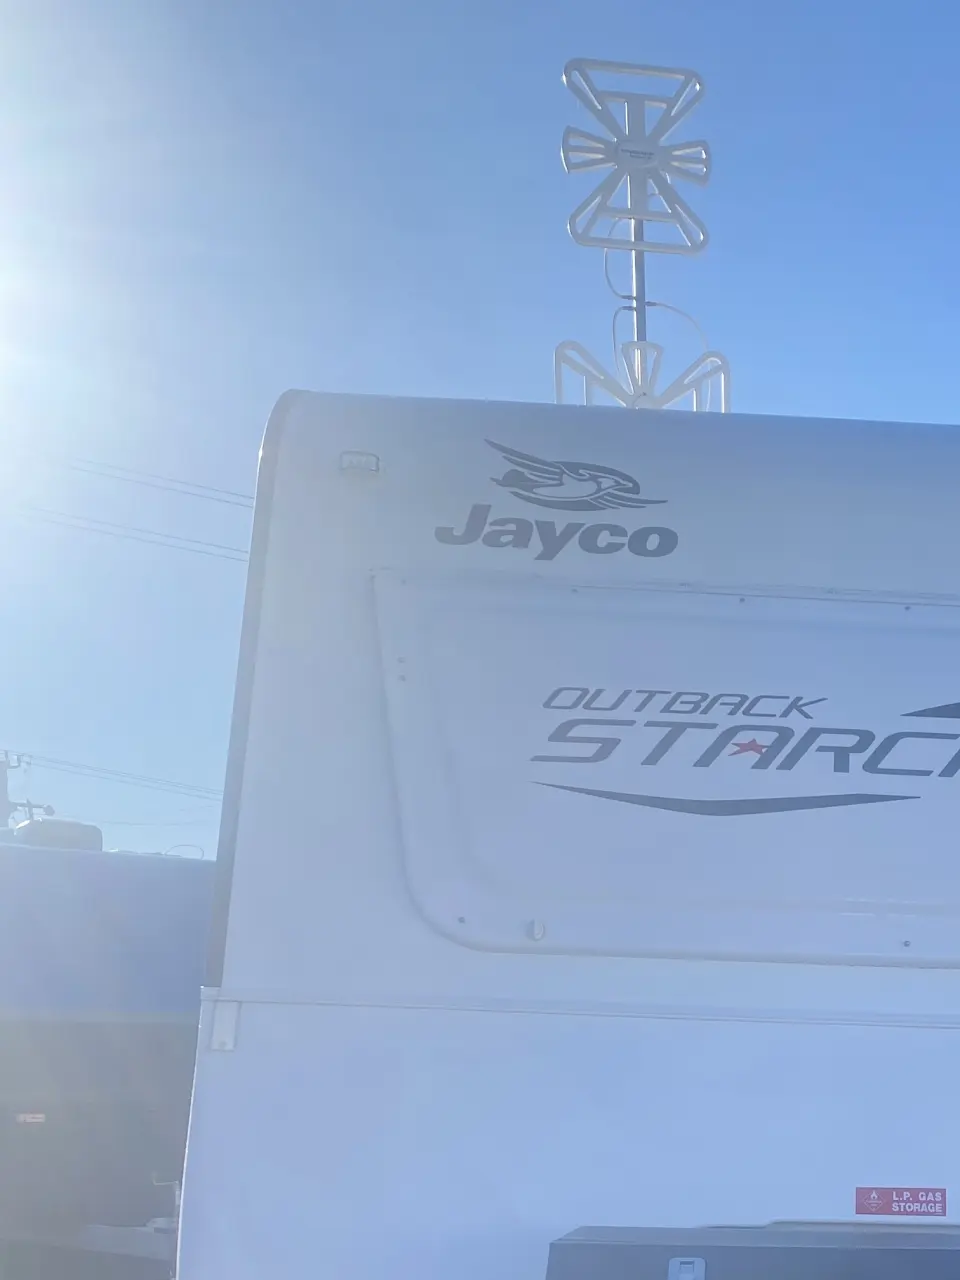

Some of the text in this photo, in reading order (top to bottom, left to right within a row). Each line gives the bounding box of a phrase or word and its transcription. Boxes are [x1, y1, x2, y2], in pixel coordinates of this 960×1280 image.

[434, 503, 679, 561] Jayco
[542, 686, 828, 719] OUTBACK
[892, 1191, 942, 1202] L.P. GAS
[892, 1202, 943, 1213] STORAGE
